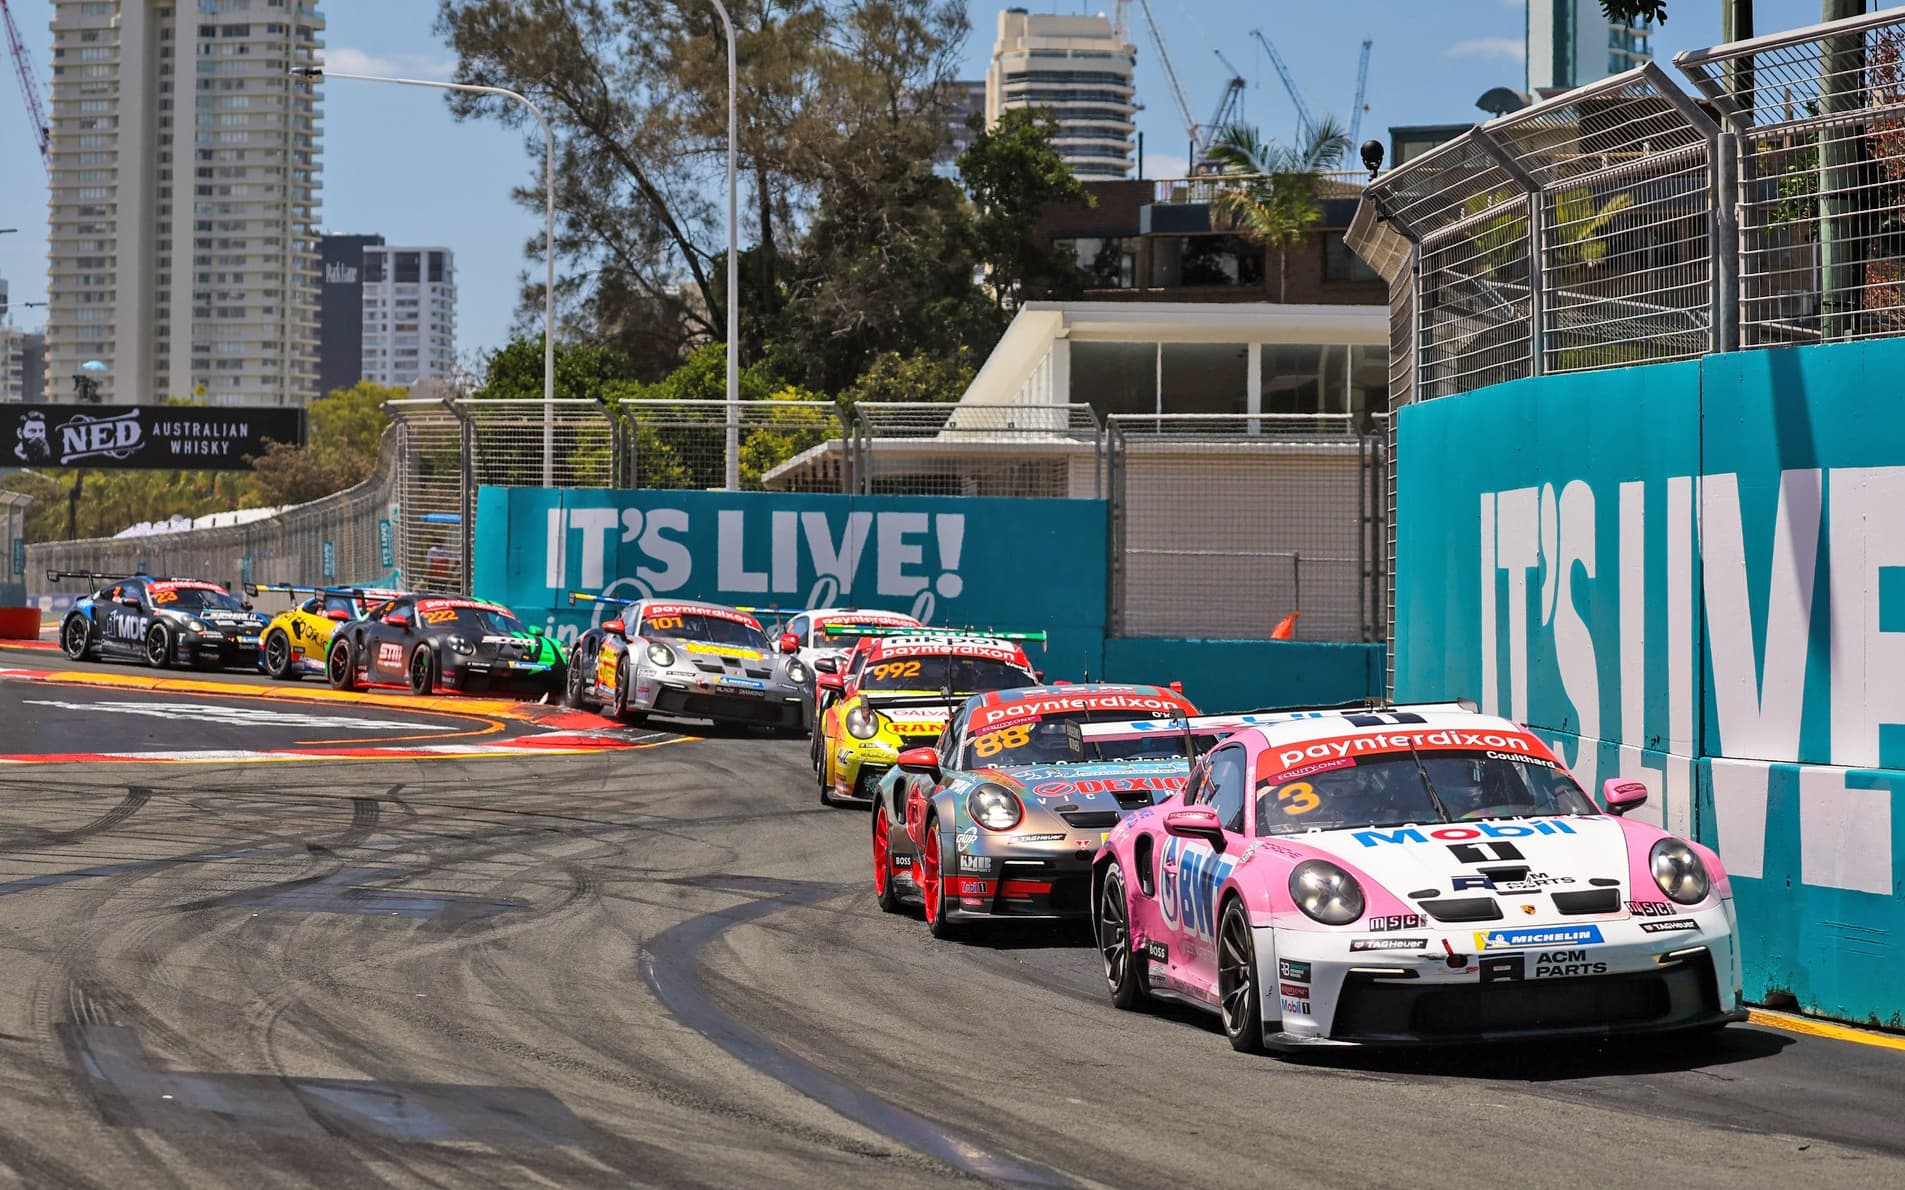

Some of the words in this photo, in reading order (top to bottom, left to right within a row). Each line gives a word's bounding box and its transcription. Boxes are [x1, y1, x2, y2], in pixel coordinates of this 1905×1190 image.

[61, 420, 143, 454] NED
[153, 421, 248, 437] AUSTRALIAN
[171, 440, 229, 456] WHISKY
[546, 507, 692, 592] IT'S
[718, 510, 966, 600] LIVE!
[154, 591, 178, 604] 23
[425, 610, 460, 624] 222
[648, 616, 685, 631] 101
[652, 605, 753, 625] paynterdixon
[882, 645, 1015, 662] paynterdixon
[872, 660, 922, 681] 992
[987, 694, 1179, 723] paynterdixon
[973, 725, 1032, 758] 88
[1279, 730, 1530, 769] paynterdixon
[1486, 750, 1557, 770] Coulthard
[1276, 782, 1321, 816] 3
[1353, 815, 1577, 848] Mobil
[896, 856, 912, 866] BOSS
[1511, 930, 1591, 944] MICHELIN
[1536, 950, 1586, 964] ACM
[1535, 962, 1608, 978] PARTS
[1281, 998, 1302, 1013] Mobil
